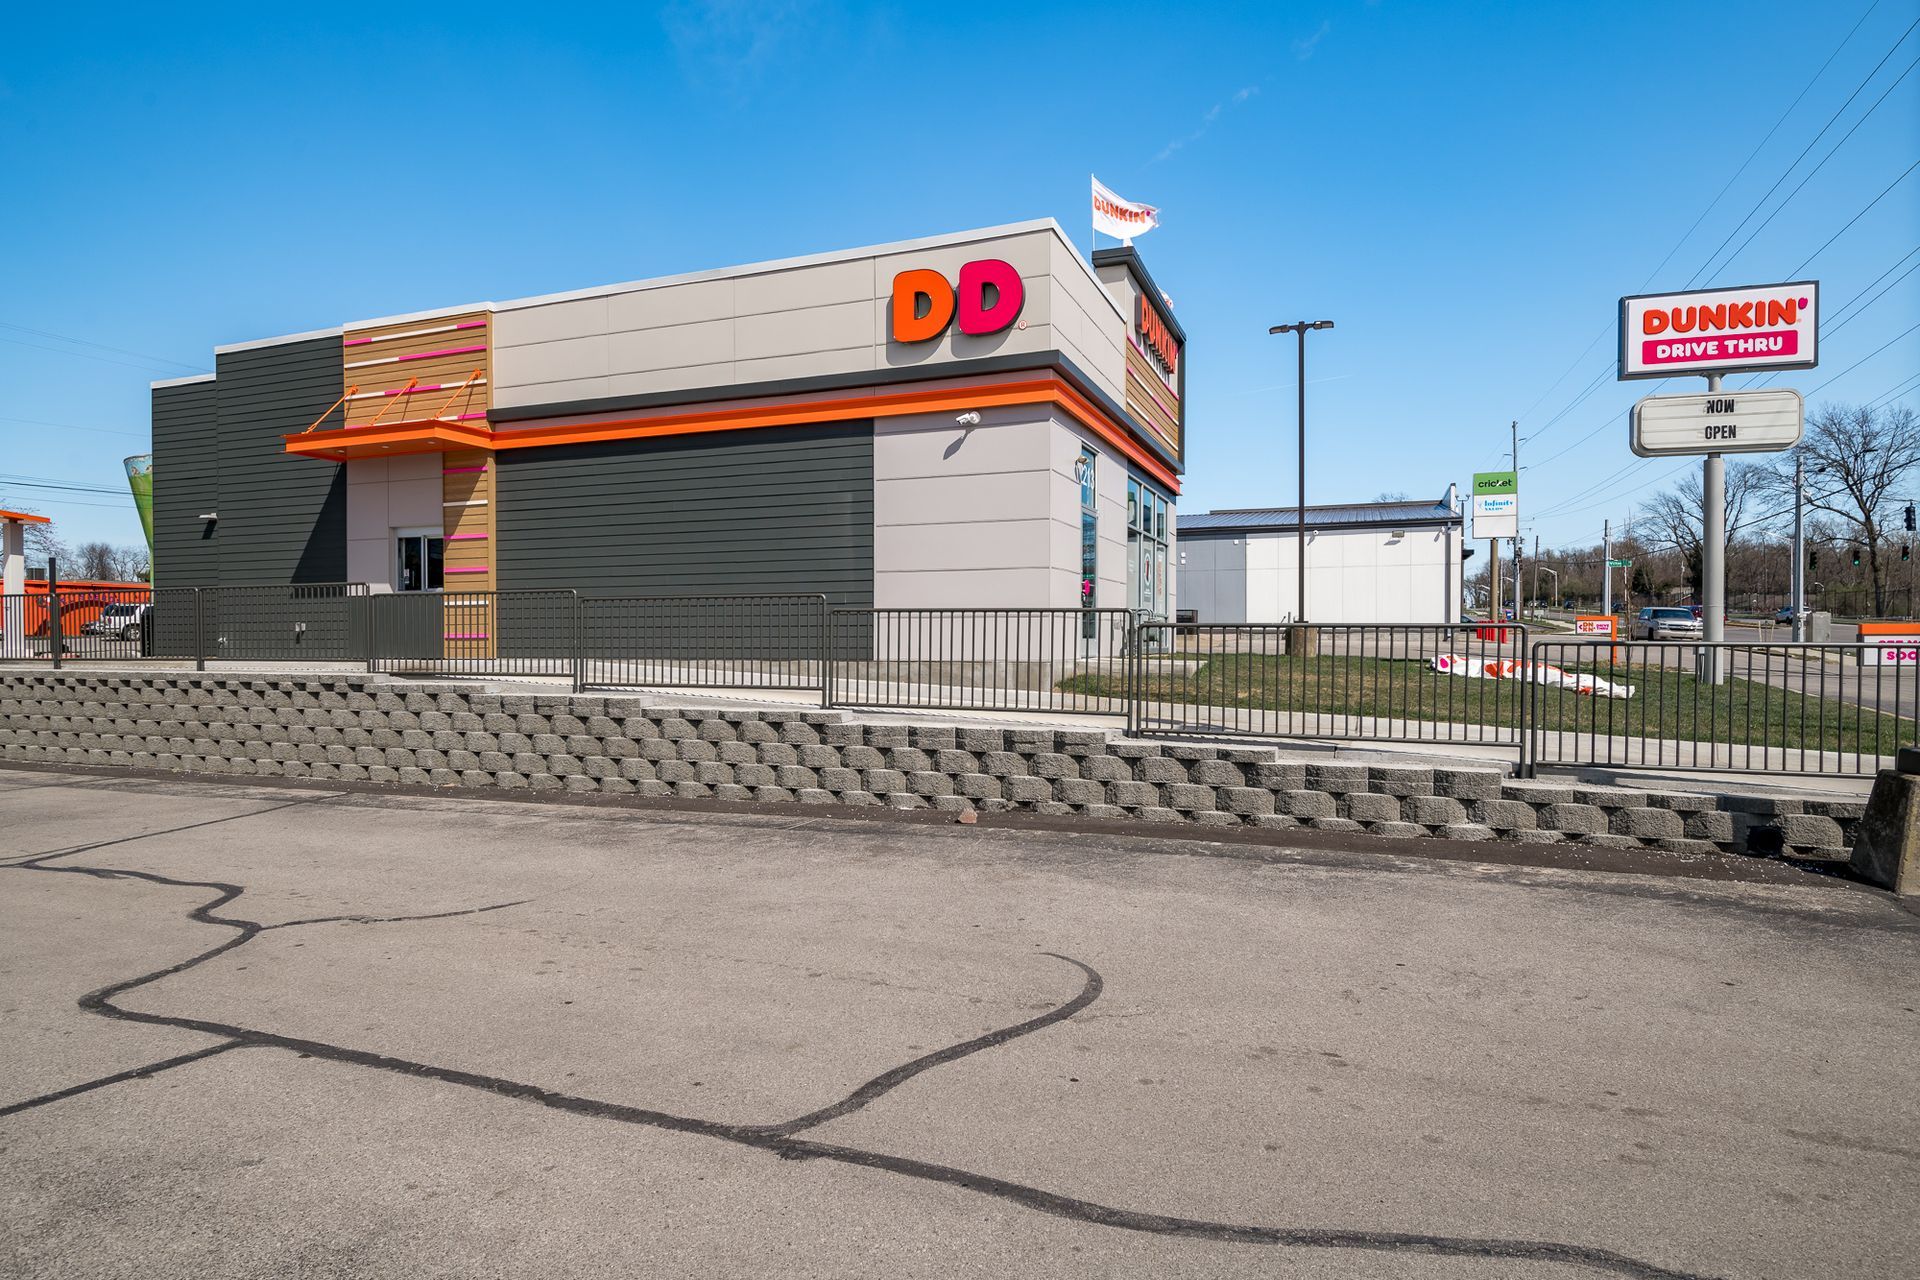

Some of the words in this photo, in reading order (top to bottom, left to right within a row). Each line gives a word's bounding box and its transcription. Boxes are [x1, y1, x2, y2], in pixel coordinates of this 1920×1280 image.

[1094, 195, 1151, 224] DUNKIN'
[893, 259, 1024, 344] DD
[1642, 297, 1809, 336] DUNKIN'
[1656, 341, 1719, 359] DRIVE
[1724, 336, 1783, 353] THRU
[1706, 399, 1735, 414] NOW
[1704, 424, 1737, 439] OPEN
[1478, 478, 1512, 488] cricket
